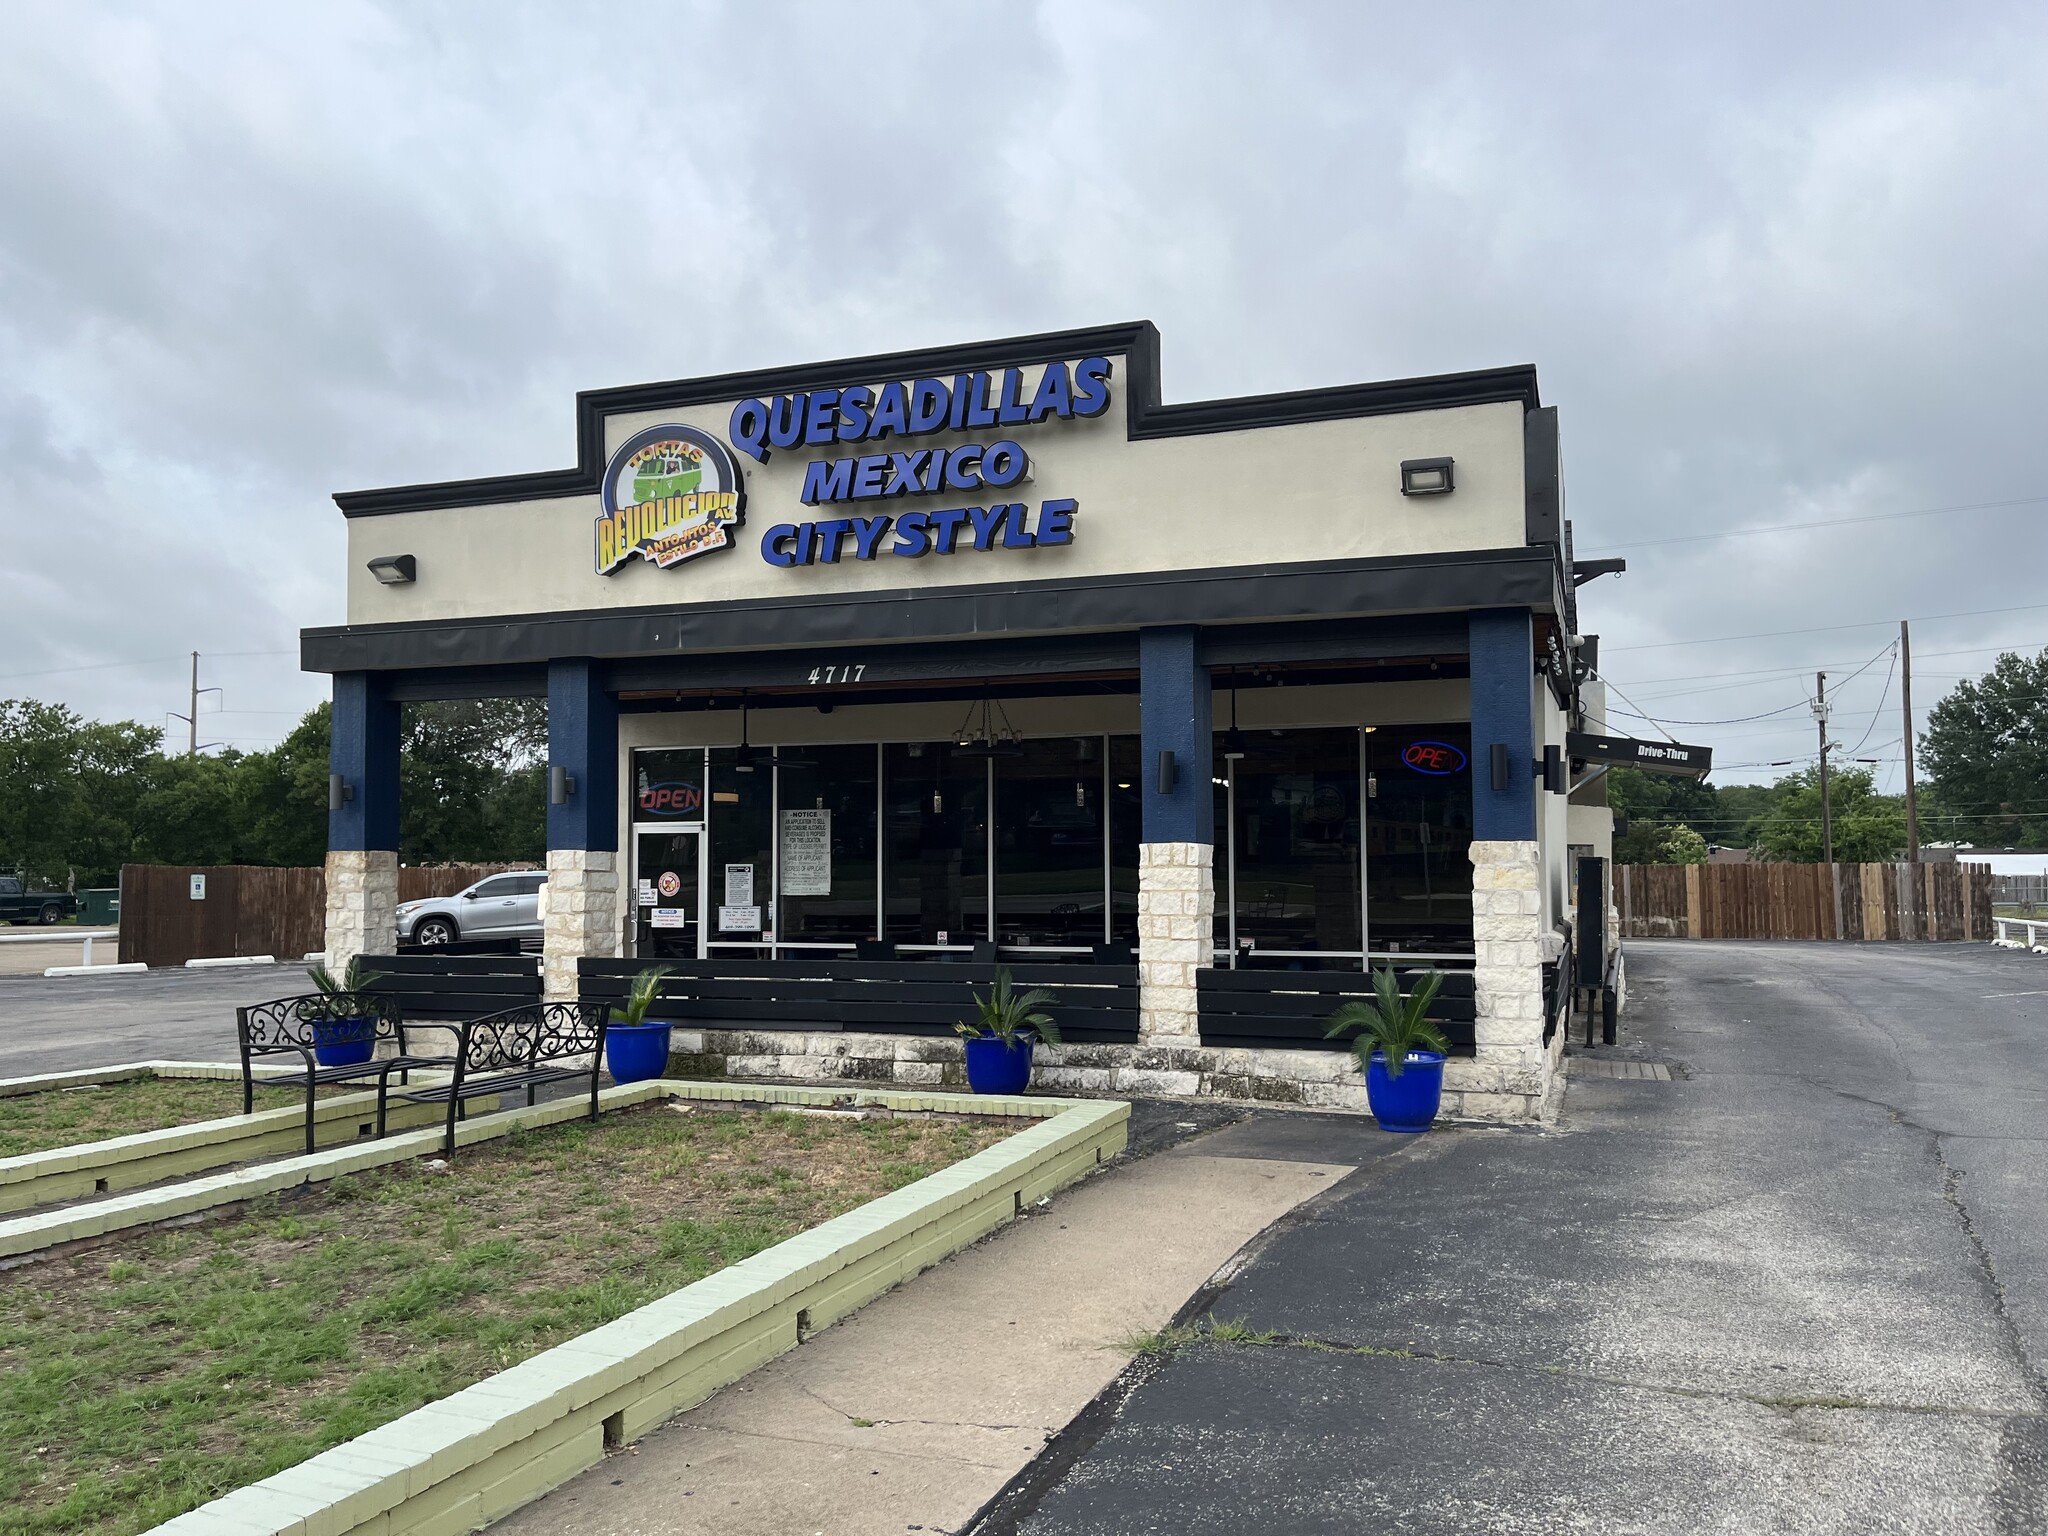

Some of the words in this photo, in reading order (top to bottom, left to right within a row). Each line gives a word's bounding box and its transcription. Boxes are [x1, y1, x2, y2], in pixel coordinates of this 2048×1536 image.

[729, 357, 1112, 465] QUESADILLAS
[629, 440, 704, 469] TORTAS
[800, 440, 1030, 506] MEXICO
[599, 491, 736, 571] REVOLUCION
[646, 521, 717, 558] ANTOJITOS
[657, 539, 699, 565] ESTILO
[808, 665, 866, 685] 4717
[1637, 745, 1689, 761] Drive-Thru
[640, 789, 702, 809] OPEN
